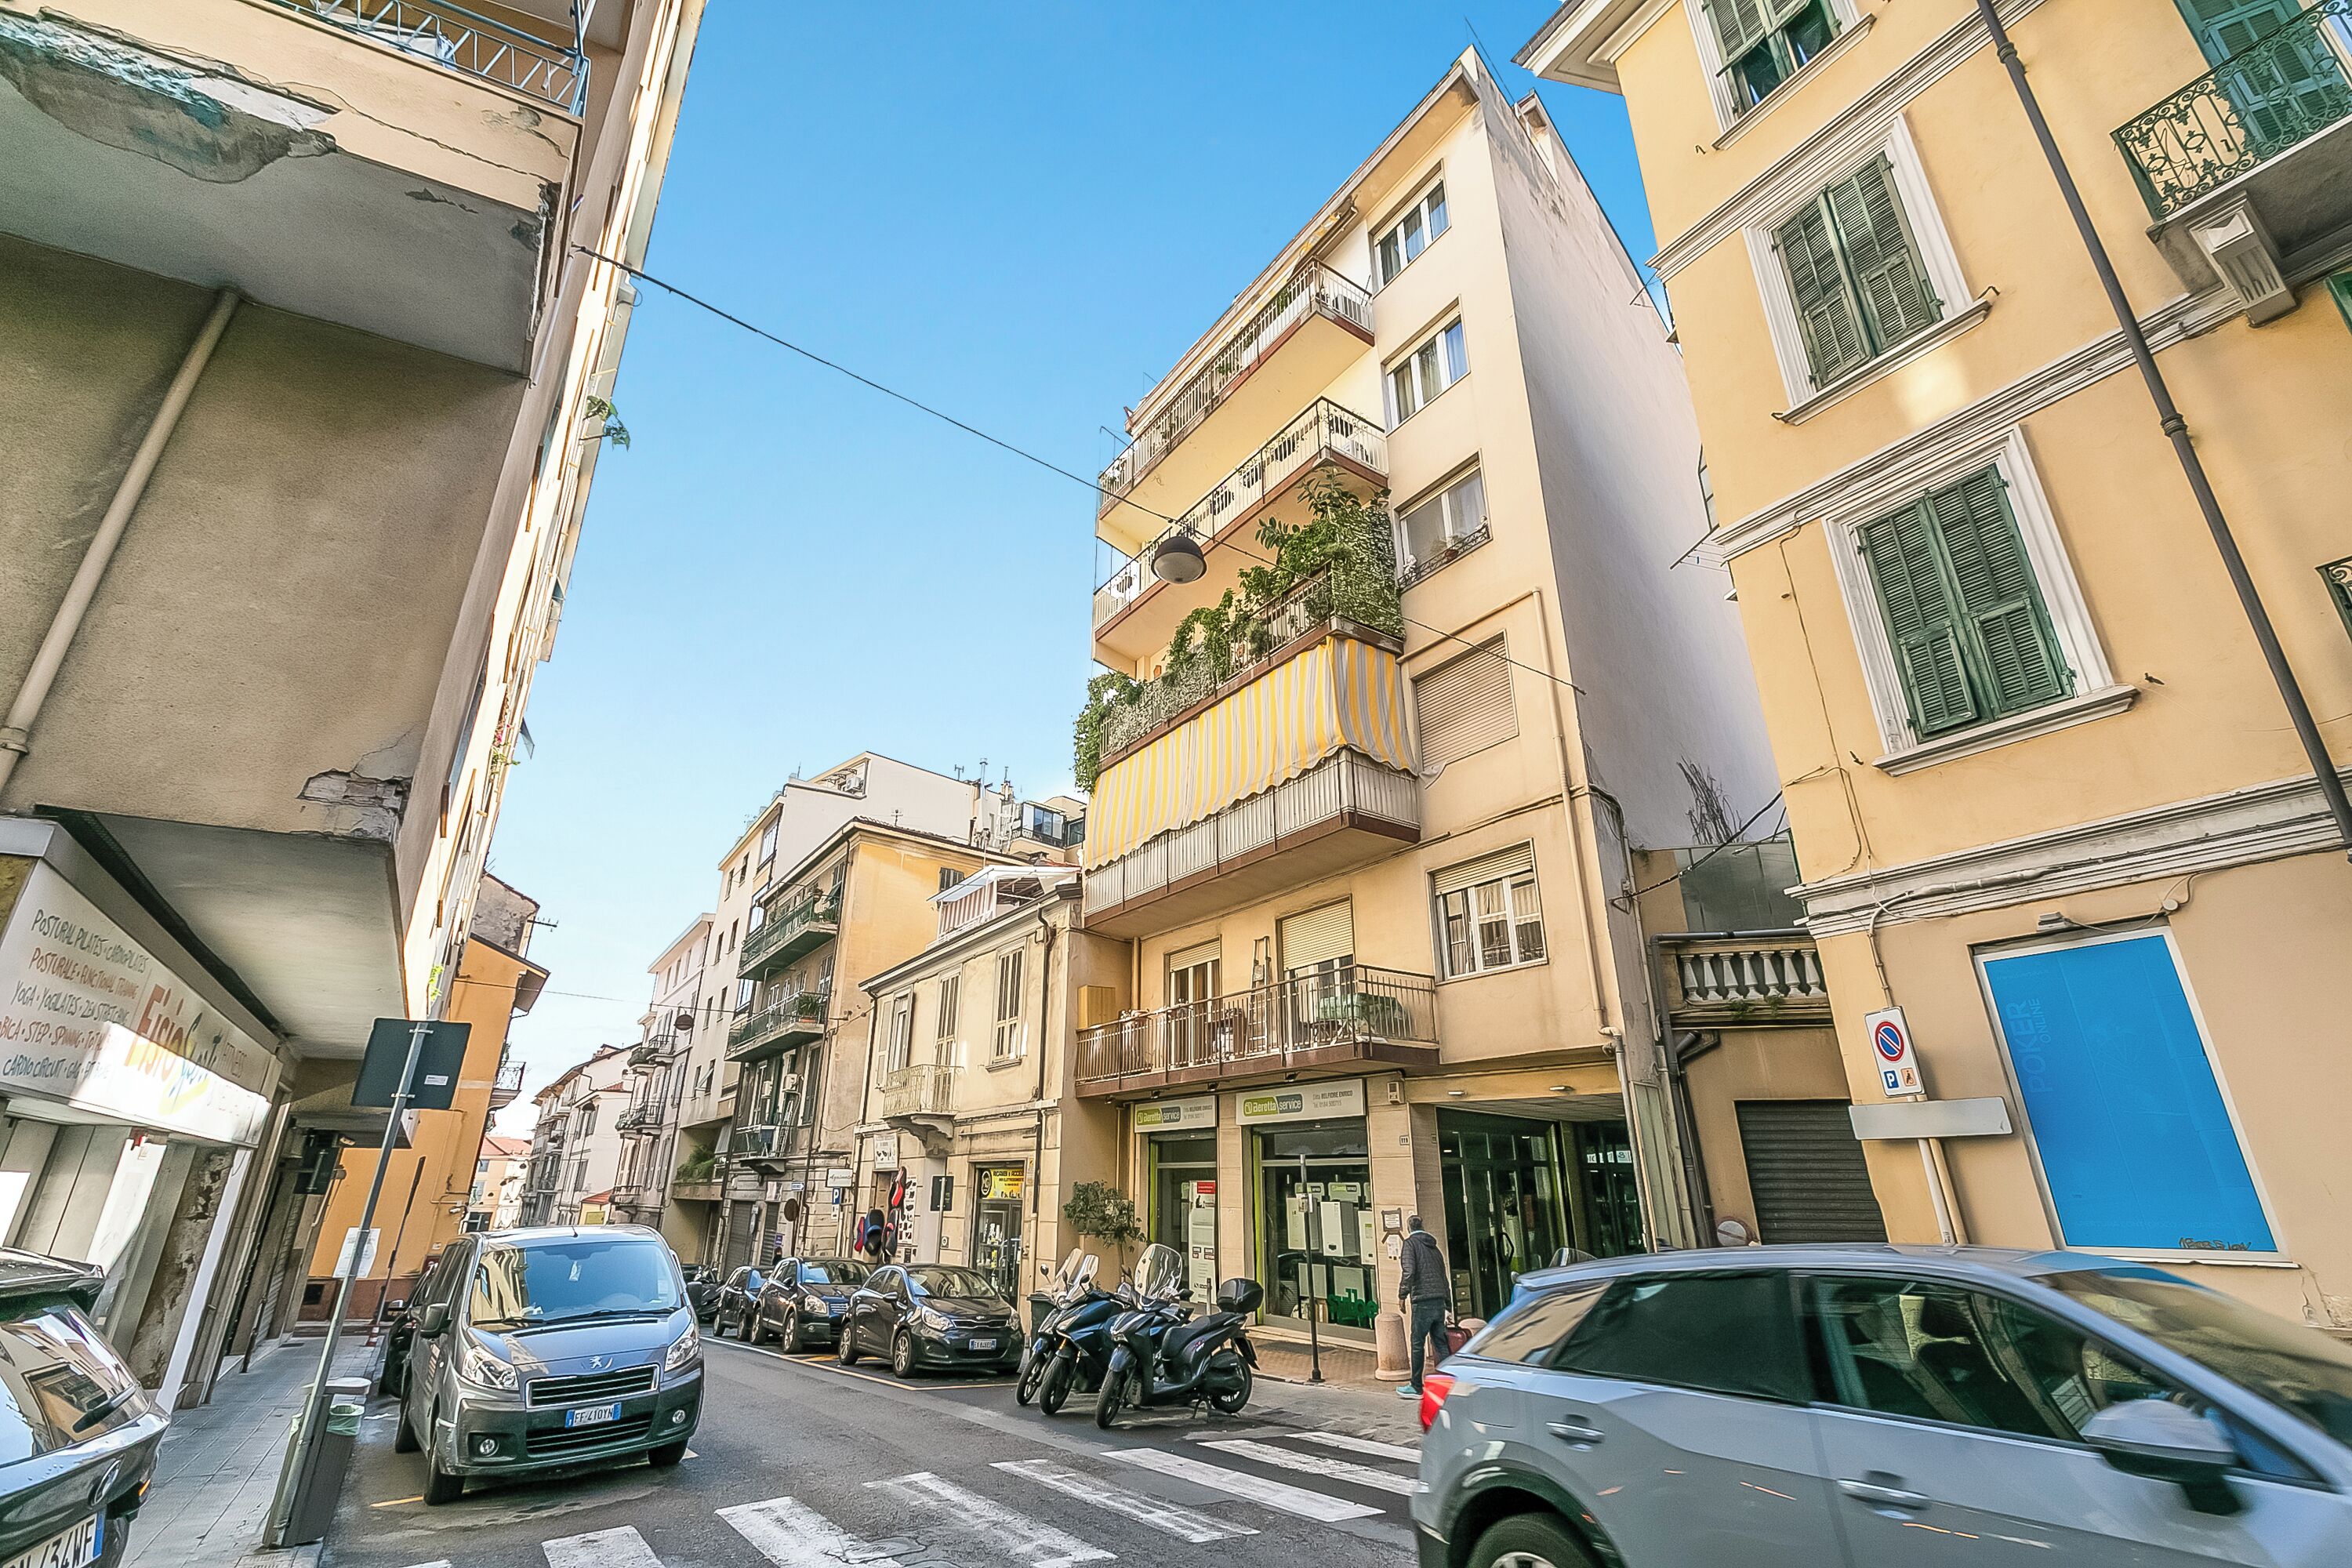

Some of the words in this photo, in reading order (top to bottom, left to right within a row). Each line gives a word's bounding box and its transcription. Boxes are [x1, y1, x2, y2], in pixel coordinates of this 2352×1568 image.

[31, 909, 76, 946] POSTURAL
[74, 927, 109, 957] PILATES
[29, 947, 78, 981] POSTURALE
[11, 980, 37, 1007] YOGA
[0, 1015, 23, 1041] BICA
[24, 1021, 50, 1044] STEP
[2028, 997, 2052, 1044] ONLINE
[2006, 1000, 2054, 1093] POKER
[3, 1054, 34, 1076] CARDIO
[33, 1057, 66, 1079] CIRCUIT
[1143, 1111, 1161, 1123] Beretta
[1163, 1109, 1180, 1121] service
[1253, 1101, 1276, 1113] Beretta
[1279, 1099, 1302, 1111] service
